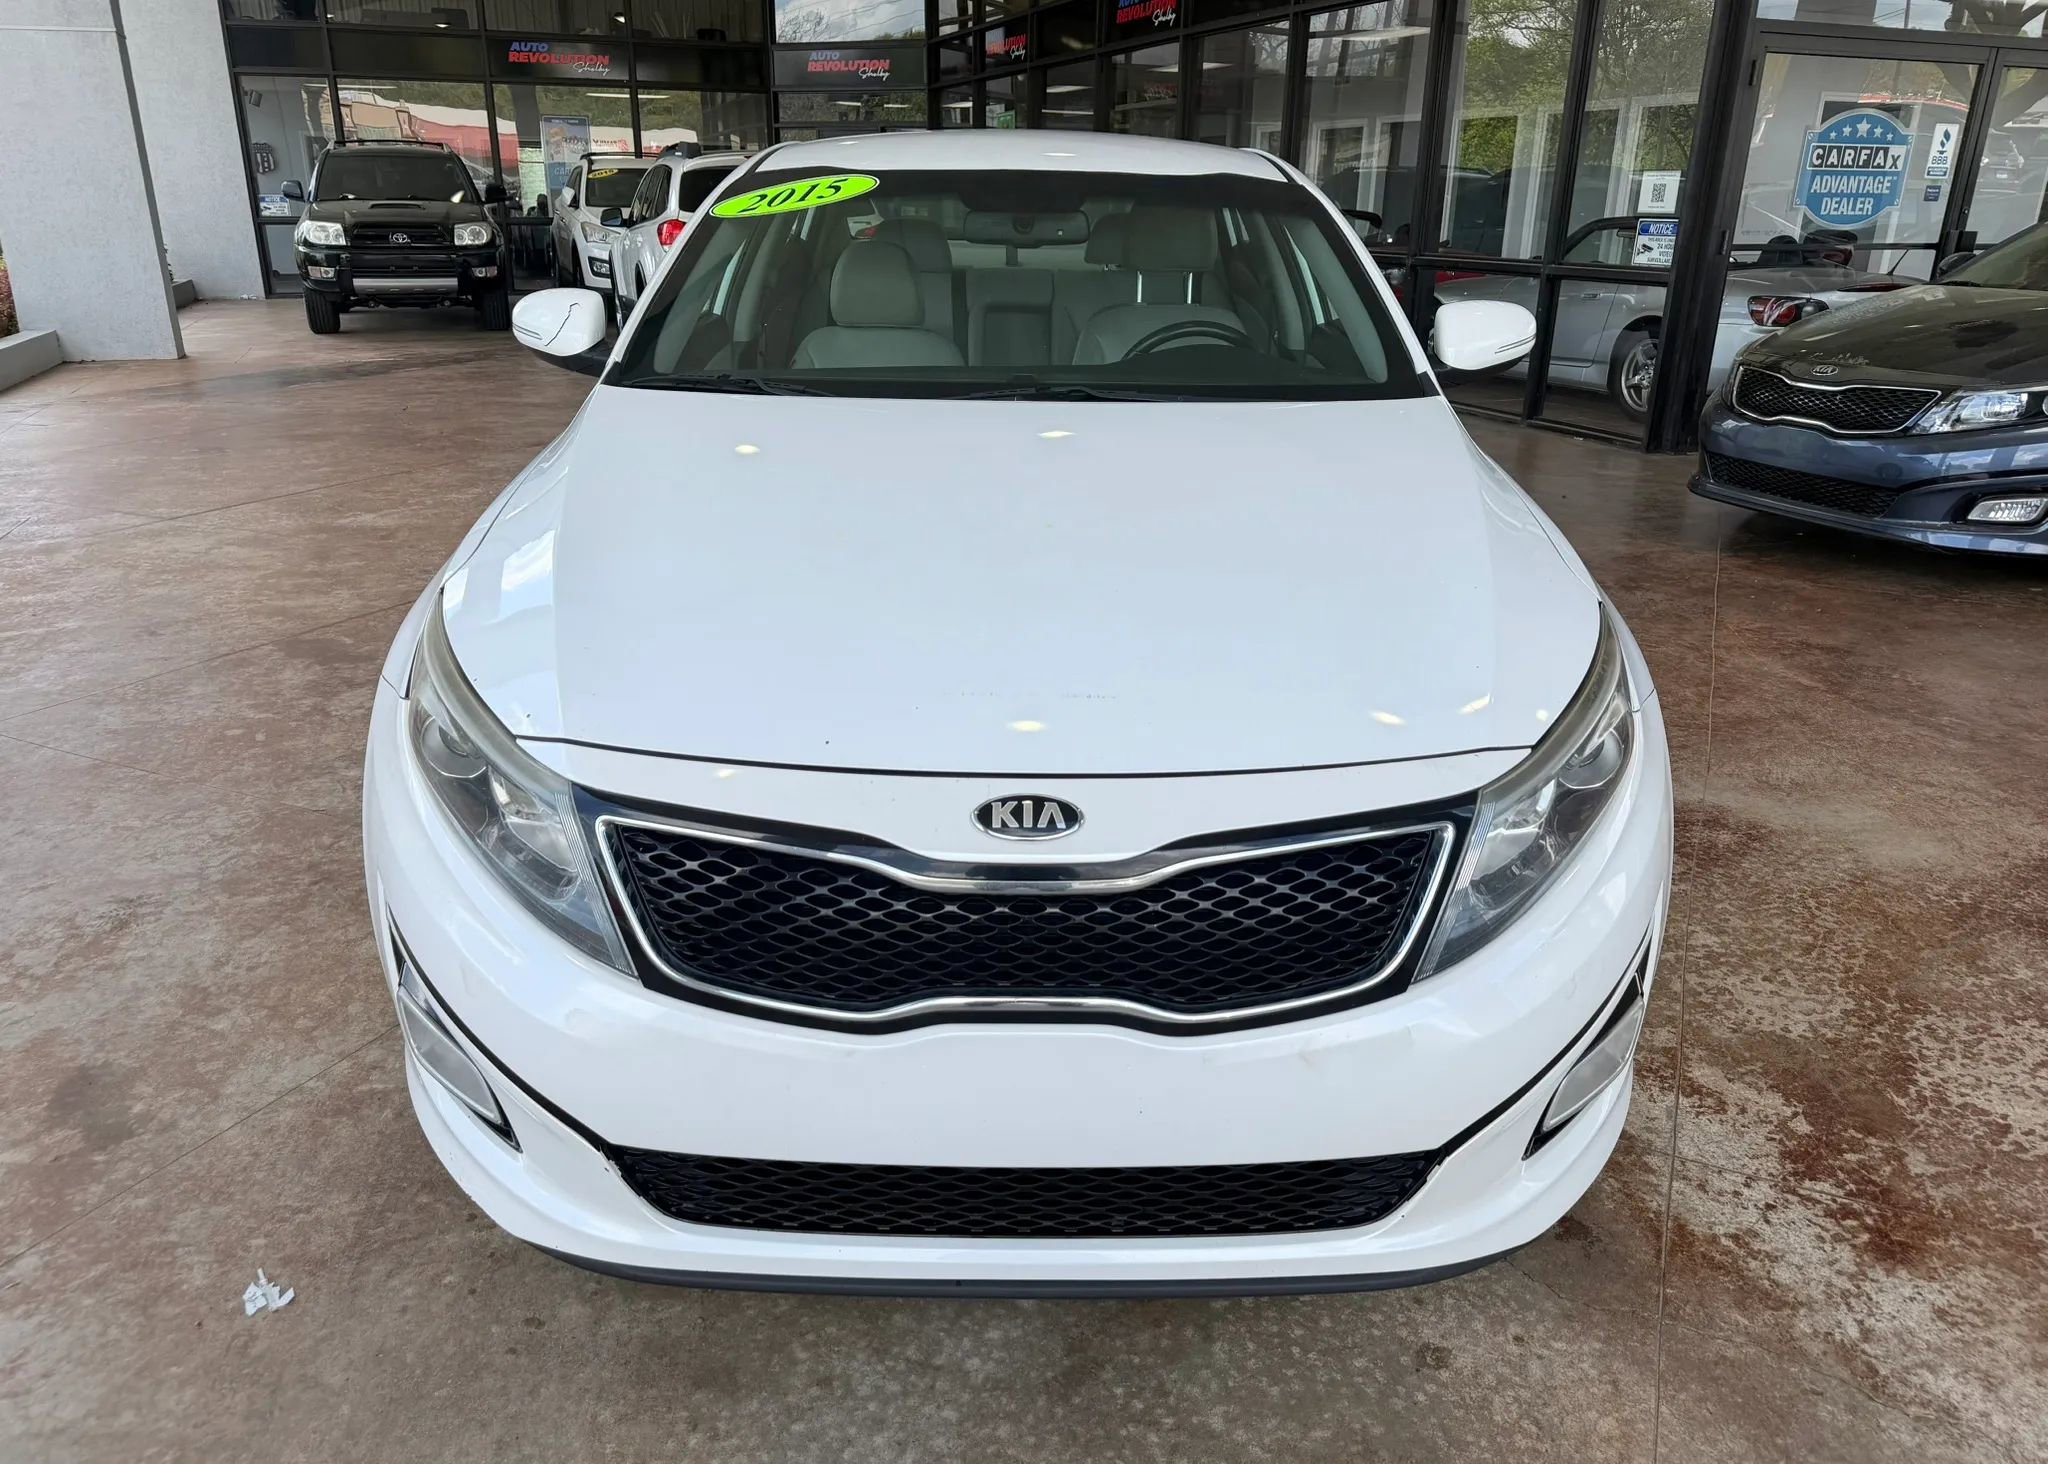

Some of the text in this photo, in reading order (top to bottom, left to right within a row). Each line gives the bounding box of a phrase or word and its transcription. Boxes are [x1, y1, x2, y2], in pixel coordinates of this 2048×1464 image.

[1115, 0, 1177, 24] REVOLUTION
[1152, 5, 1177, 27] Shelby
[510, 41, 549, 52] AUTO
[508, 51, 610, 65] REVOLUTION
[809, 51, 840, 60] AUTO
[573, 61, 610, 76] Shelby
[807, 59, 890, 72] REVOLUTION
[858, 67, 891, 81] Shelby
[1811, 147, 1902, 170] CARFAX
[1931, 155, 1948, 165] BBB
[1810, 175, 1893, 194] ADVANTAGE
[737, 178, 849, 214] 2015
[1820, 197, 1874, 215] DEALER
[1648, 223, 1675, 234] NOTICE
[1659, 250, 1673, 258] VIDEO
[1813, 365, 1834, 374] KIA
[991, 800, 1067, 829] KIA
